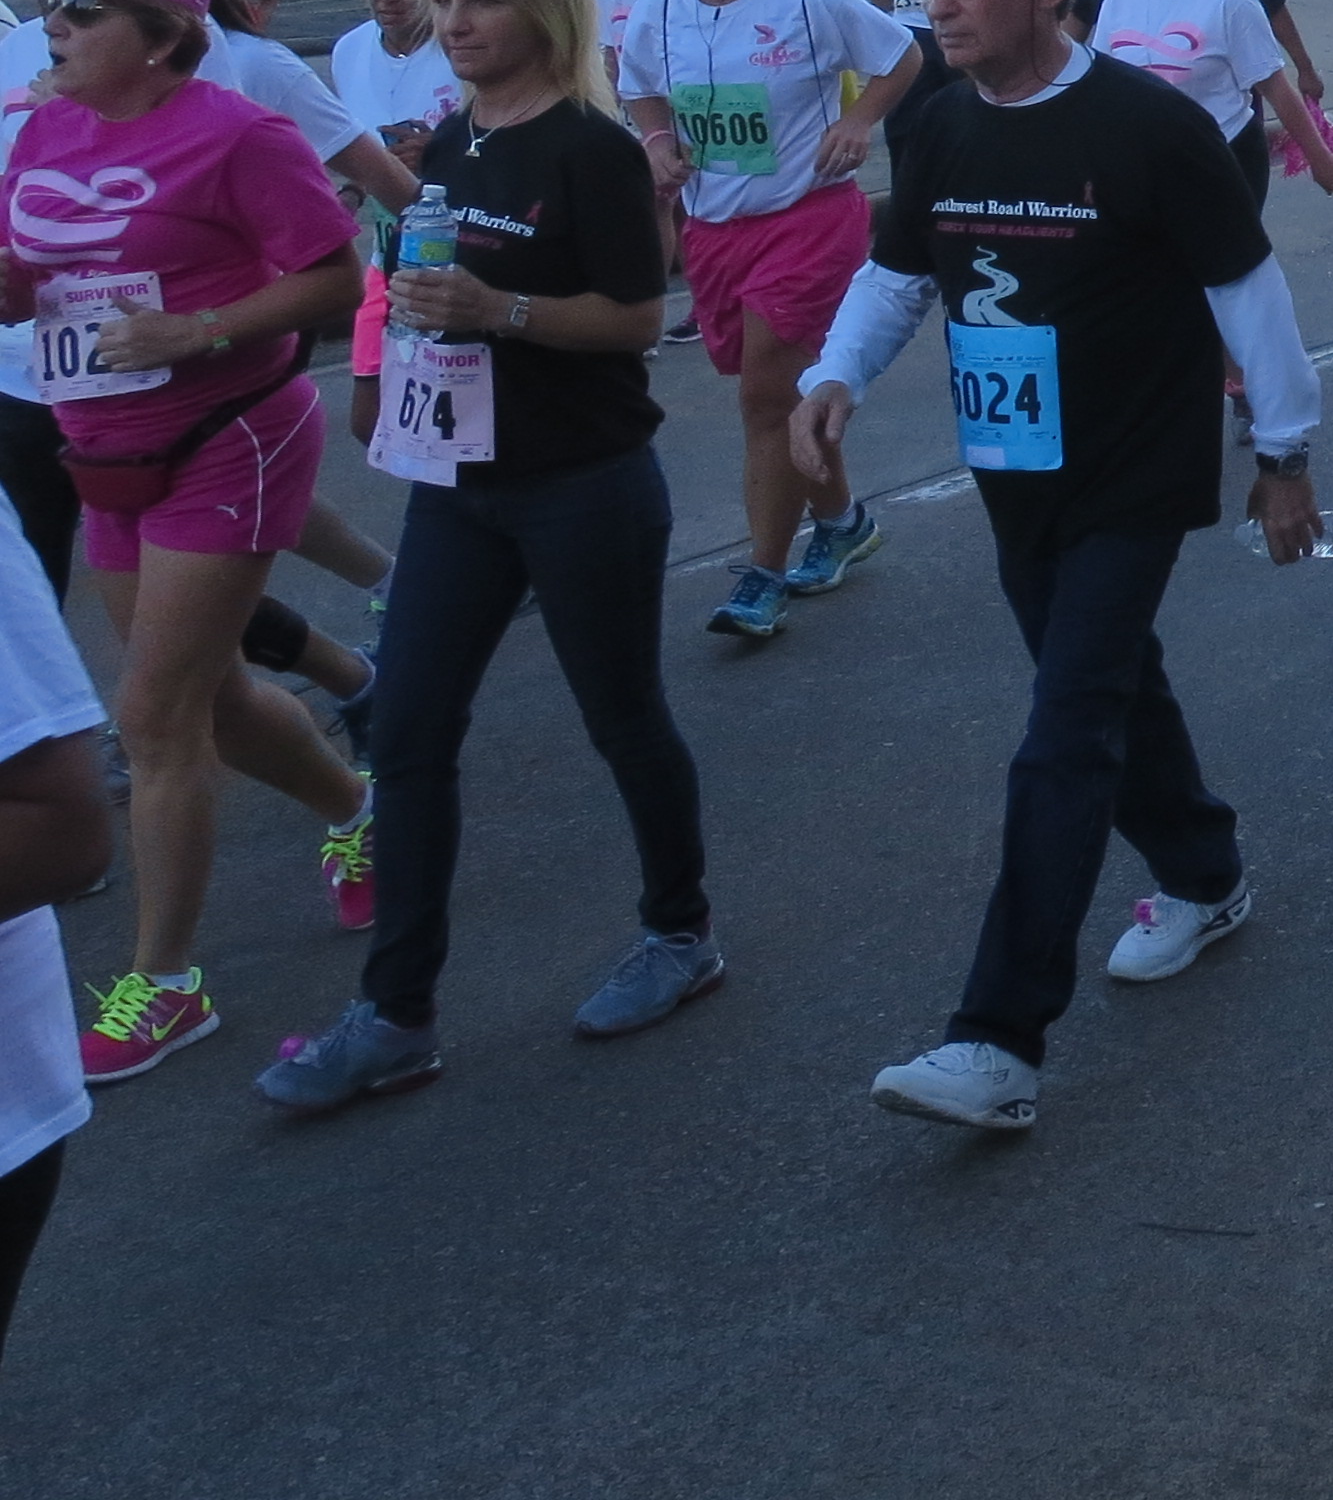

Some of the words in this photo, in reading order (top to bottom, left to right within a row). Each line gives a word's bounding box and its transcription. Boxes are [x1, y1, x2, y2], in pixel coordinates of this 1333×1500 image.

[467, 207, 536, 238] Warriors
[987, 199, 1024, 216] Road
[1026, 201, 1098, 220] Warriors
[398, 377, 456, 440] 674
